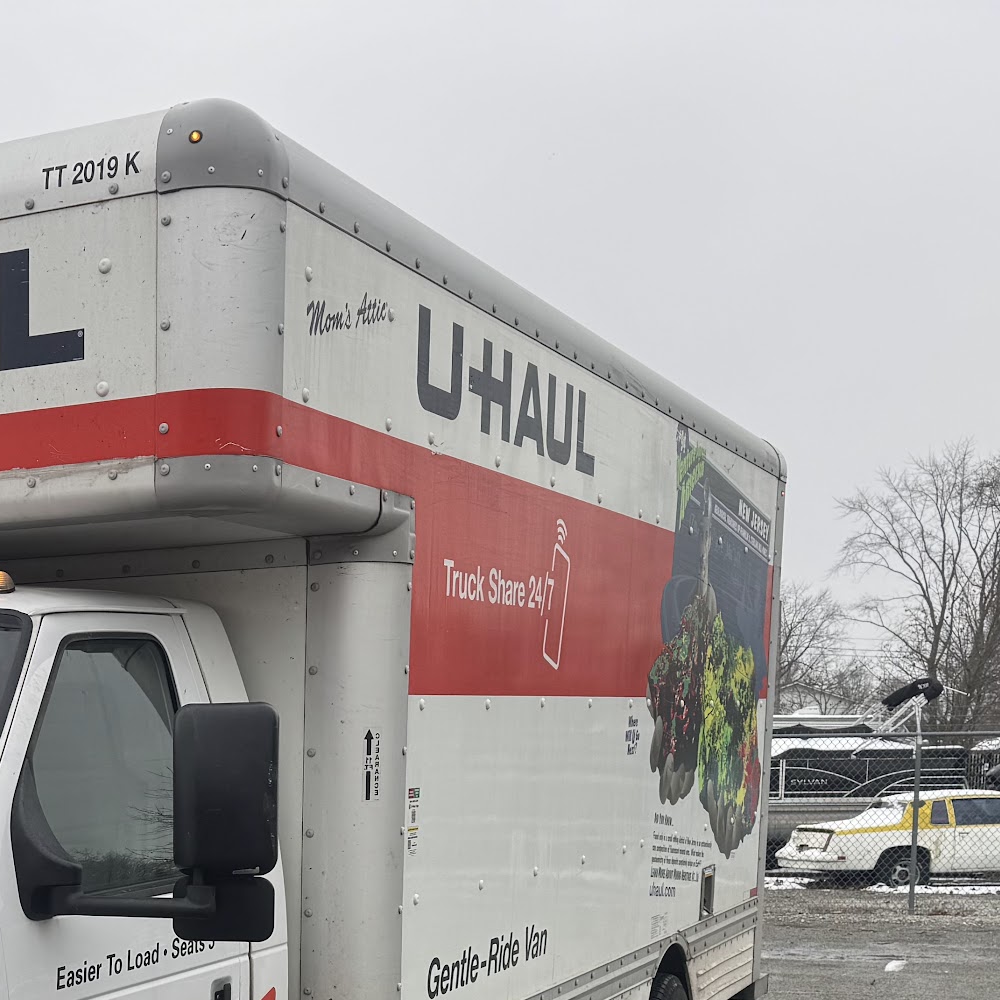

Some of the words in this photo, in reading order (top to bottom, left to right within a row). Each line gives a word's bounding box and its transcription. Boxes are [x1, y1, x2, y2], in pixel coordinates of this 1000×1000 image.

[42, 164, 68, 190] TT
[71, 155, 119, 186] 2019
[125, 150, 140, 176] K
[306, 300, 352, 336] Mom's
[416, 303, 596, 478] U-HAUL
[443, 558, 485, 602] Truck
[488, 567, 525, 608] Share
[527, 571, 555, 617] 24/7
[790, 778, 829, 786] SYLVAN
[56, 961, 103, 991] Easier
[106, 953, 123, 977] To
[127, 942, 161, 972] Load
[427, 931, 521, 1000] Gentle-Ride
[525, 923, 548, 962] Van
